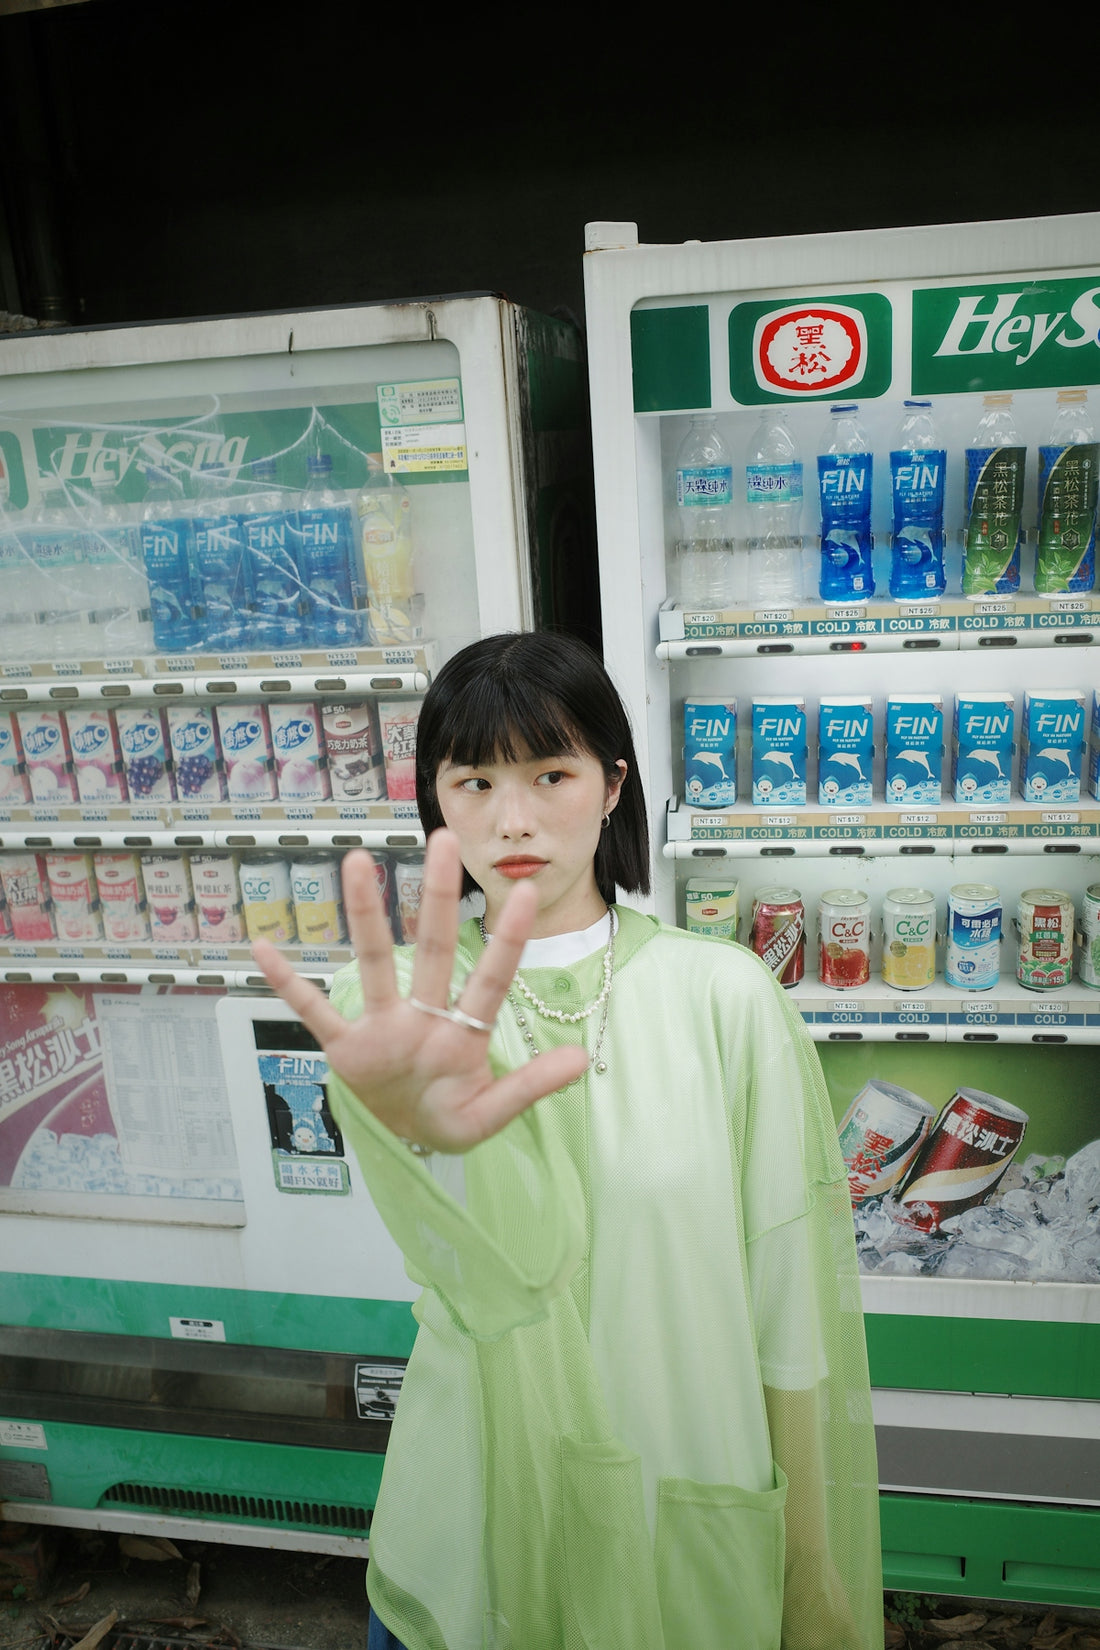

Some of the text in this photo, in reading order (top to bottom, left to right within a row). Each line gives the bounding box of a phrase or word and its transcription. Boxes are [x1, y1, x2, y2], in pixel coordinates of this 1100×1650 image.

[932, 286, 1100, 366] HeyS
[788, 324, 832, 376] 黑松
[38, 431, 250, 489] HeySong
[821, 469, 865, 493] FIN
[894, 465, 939, 490] FIN
[993, 462, 1008, 526] 黑松茶花
[1064, 460, 1080, 526] 黑松茶花
[197, 531, 232, 552] FIN
[248, 524, 285, 548] FIN
[302, 523, 338, 545] FIN
[143, 534, 179, 556] FIN
[816, 621, 876, 633] COLD 冷飲
[890, 619, 950, 631] COLD 冷飲
[964, 616, 1026, 628] COLD 冷飲
[1039, 614, 1100, 626] COLD 冷飲
[684, 625, 736, 637] COLD 冷飲
[744, 623, 804, 635] COLD 冷飲
[333, 705, 345, 714] 50
[689, 718, 730, 737] FIN
[758, 718, 801, 736] FIN
[826, 719, 868, 737] FIN
[893, 717, 938, 735] FIN
[965, 715, 1010, 734] FIN
[1035, 713, 1081, 732] FIN
[328, 733, 368, 750] 巧克力奶茶
[691, 828, 742, 839] COLD 冷飲
[751, 828, 807, 839] COLD 冷飲
[820, 827, 877, 838] COLD 冷飲
[889, 826, 947, 837] COLD 冷飲
[960, 826, 1018, 836] COLD 冷飲
[1032, 825, 1091, 836] COLD 冷飲
[244, 881, 270, 896] C&C
[294, 881, 319, 896] C&C
[701, 893, 713, 901] 50
[832, 921, 864, 938] C&C
[896, 920, 929, 937] C&C
[1034, 917, 1059, 928] 黑松
[832, 1013, 863, 1022] COLD
[898, 1013, 930, 1023] COLD
[966, 1014, 998, 1023] COLD
[1034, 1014, 1067, 1024] COLD
[277, 1058, 315, 1075] FIN
[942, 1111, 1014, 1157] 黑松沙士
